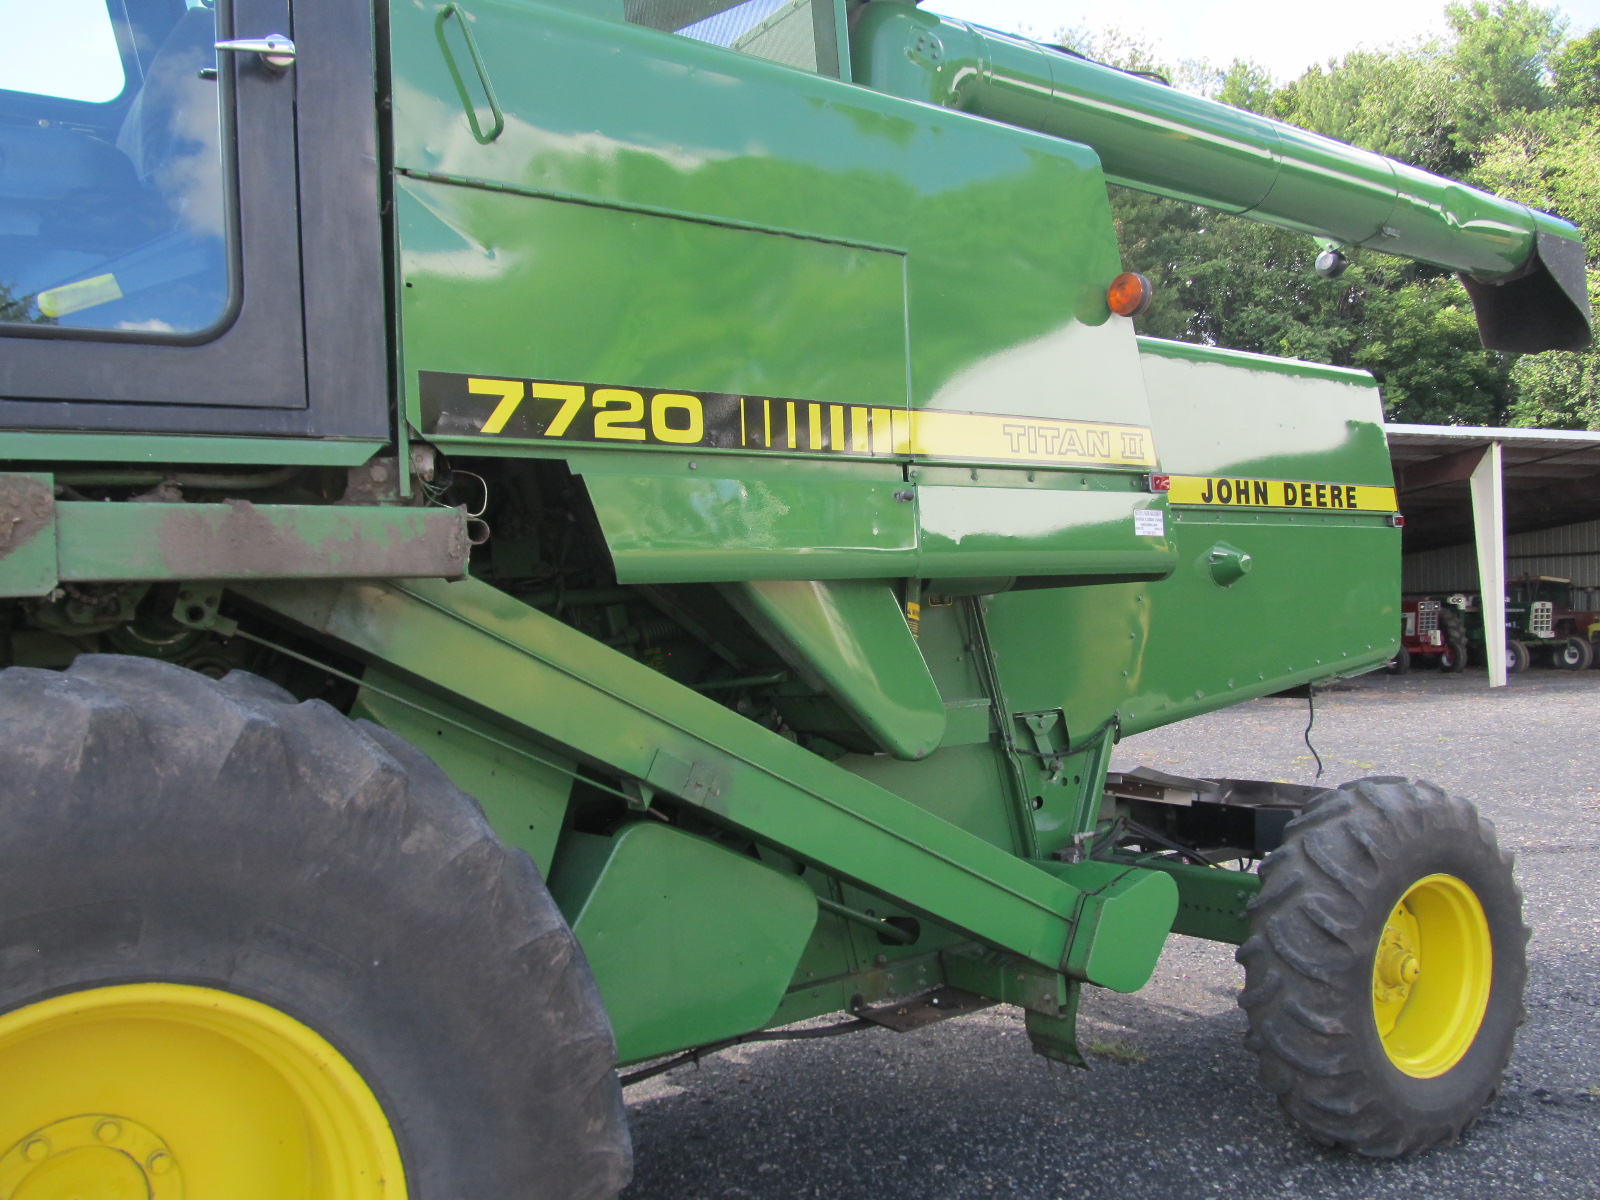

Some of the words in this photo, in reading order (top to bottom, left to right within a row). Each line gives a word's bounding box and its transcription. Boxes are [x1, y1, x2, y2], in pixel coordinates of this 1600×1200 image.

[468, 378, 704, 443] 7720
[1003, 424, 1110, 458] TITAN
[1121, 432, 1144, 459] II
[1201, 479, 1268, 505] JOHN
[1283, 482, 1358, 508] DEERE
